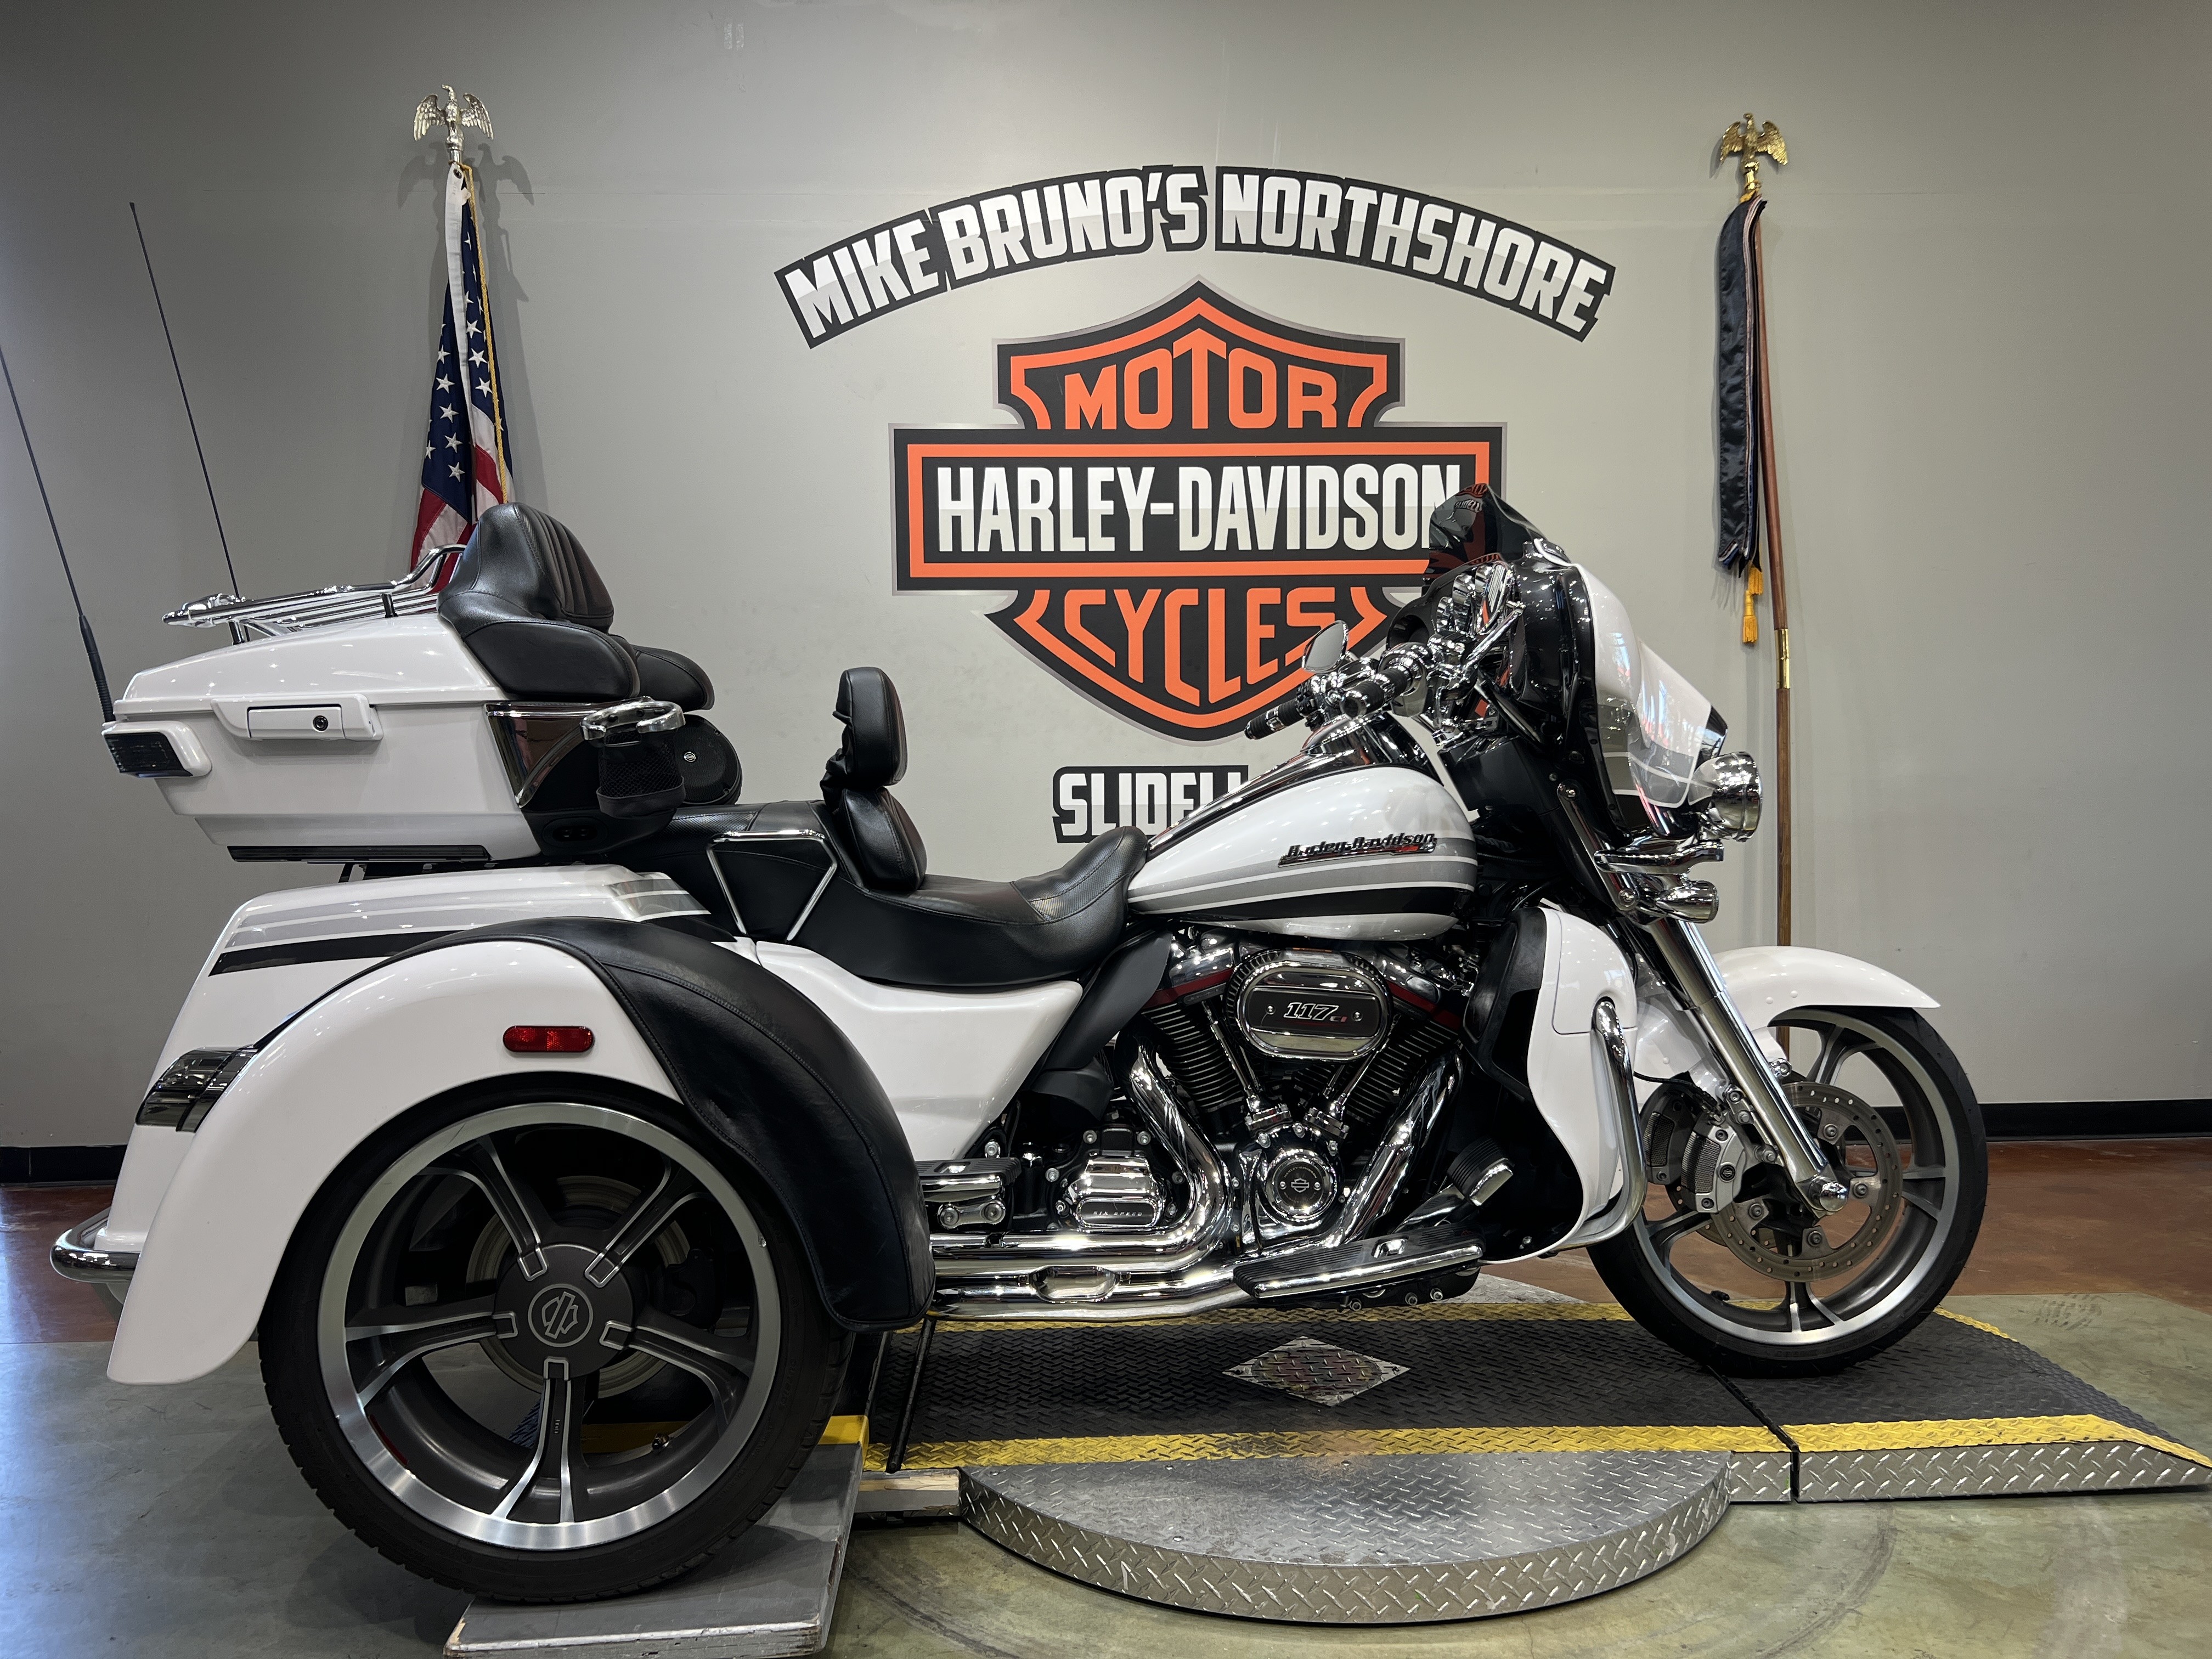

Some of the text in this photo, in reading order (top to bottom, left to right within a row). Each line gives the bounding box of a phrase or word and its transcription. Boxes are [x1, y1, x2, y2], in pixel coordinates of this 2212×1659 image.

[785, 172, 1607, 338] MIKE BRUNO'S NORTHSHORE
[1064, 328, 1338, 430] MOTOR
[1064, 588, 1335, 707] CYCLES
[1059, 772, 1242, 836] SLIDE
[1283, 1002, 1339, 1021] 117
